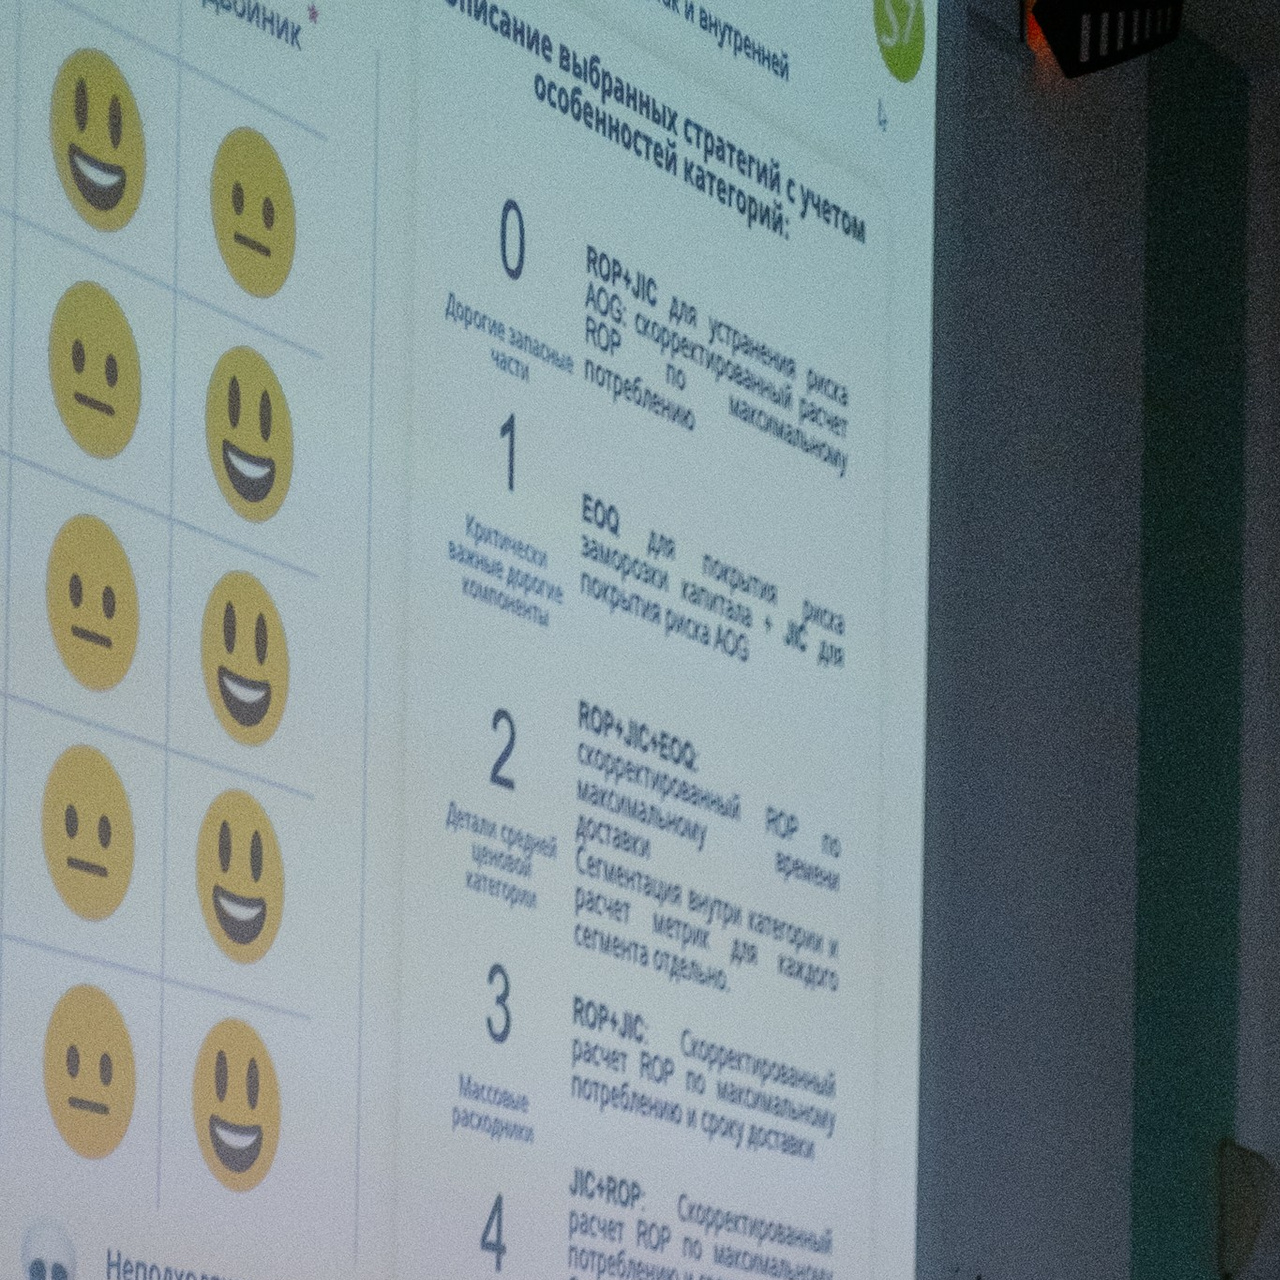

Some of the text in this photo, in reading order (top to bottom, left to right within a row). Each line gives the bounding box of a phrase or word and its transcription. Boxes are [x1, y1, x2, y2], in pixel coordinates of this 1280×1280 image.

[684, 0, 790, 82] и внутренней
[534, 74, 790, 241] особенностей категорий:
[559, 43, 679, 134] выбранных
[684, 118, 781, 194] стратегий
[787, 175, 796, 204] с
[800, 182, 866, 245] учетом
[501, 199, 524, 280] 0
[445, 292, 505, 342] Дорогие
[587, 244, 848, 407] ROP+JIC для устранения риска
[490, 347, 530, 383] части
[584, 358, 695, 432] потреблению
[585, 317, 848, 478] ROP по максимальному
[635, 313, 793, 410] скорректированный
[799, 397, 847, 438] расчет
[500, 413, 515, 492] 1
[507, 566, 563, 605] дорогие
[582, 493, 845, 636] EOQ для покрытия риска
[580, 572, 748, 662] покрытия риска AOG
[817, 640, 845, 668] для
[490, 708, 515, 789] 2
[445, 801, 557, 860] Детали средней
[578, 740, 842, 858] скорректированный ROP по
[578, 778, 708, 850] максимальному
[465, 869, 537, 909] категории
[574, 887, 630, 925] расчет
[653, 912, 710, 950] метрик
[730, 938, 758, 966] для
[575, 846, 839, 958] Сегментация внутри категории и
[574, 923, 649, 968] сегмента
[486, 963, 513, 1045] 3
[458, 1073, 529, 1114] Массовые
[572, 1037, 837, 1138] расчет ROP по максимальному
[680, 1029, 836, 1099] Скорректированный
[452, 1107, 534, 1144] расходники
[571, 1074, 682, 1126] потреблению
[686, 1108, 697, 1129] и
[700, 1111, 745, 1149] сроку
[479, 1193, 507, 1273] 4
[568, 1209, 624, 1244] расчет
[636, 1219, 671, 1254] ROP
[682, 1232, 703, 1260] по
[676, 1193, 833, 1256] Скорректированный
